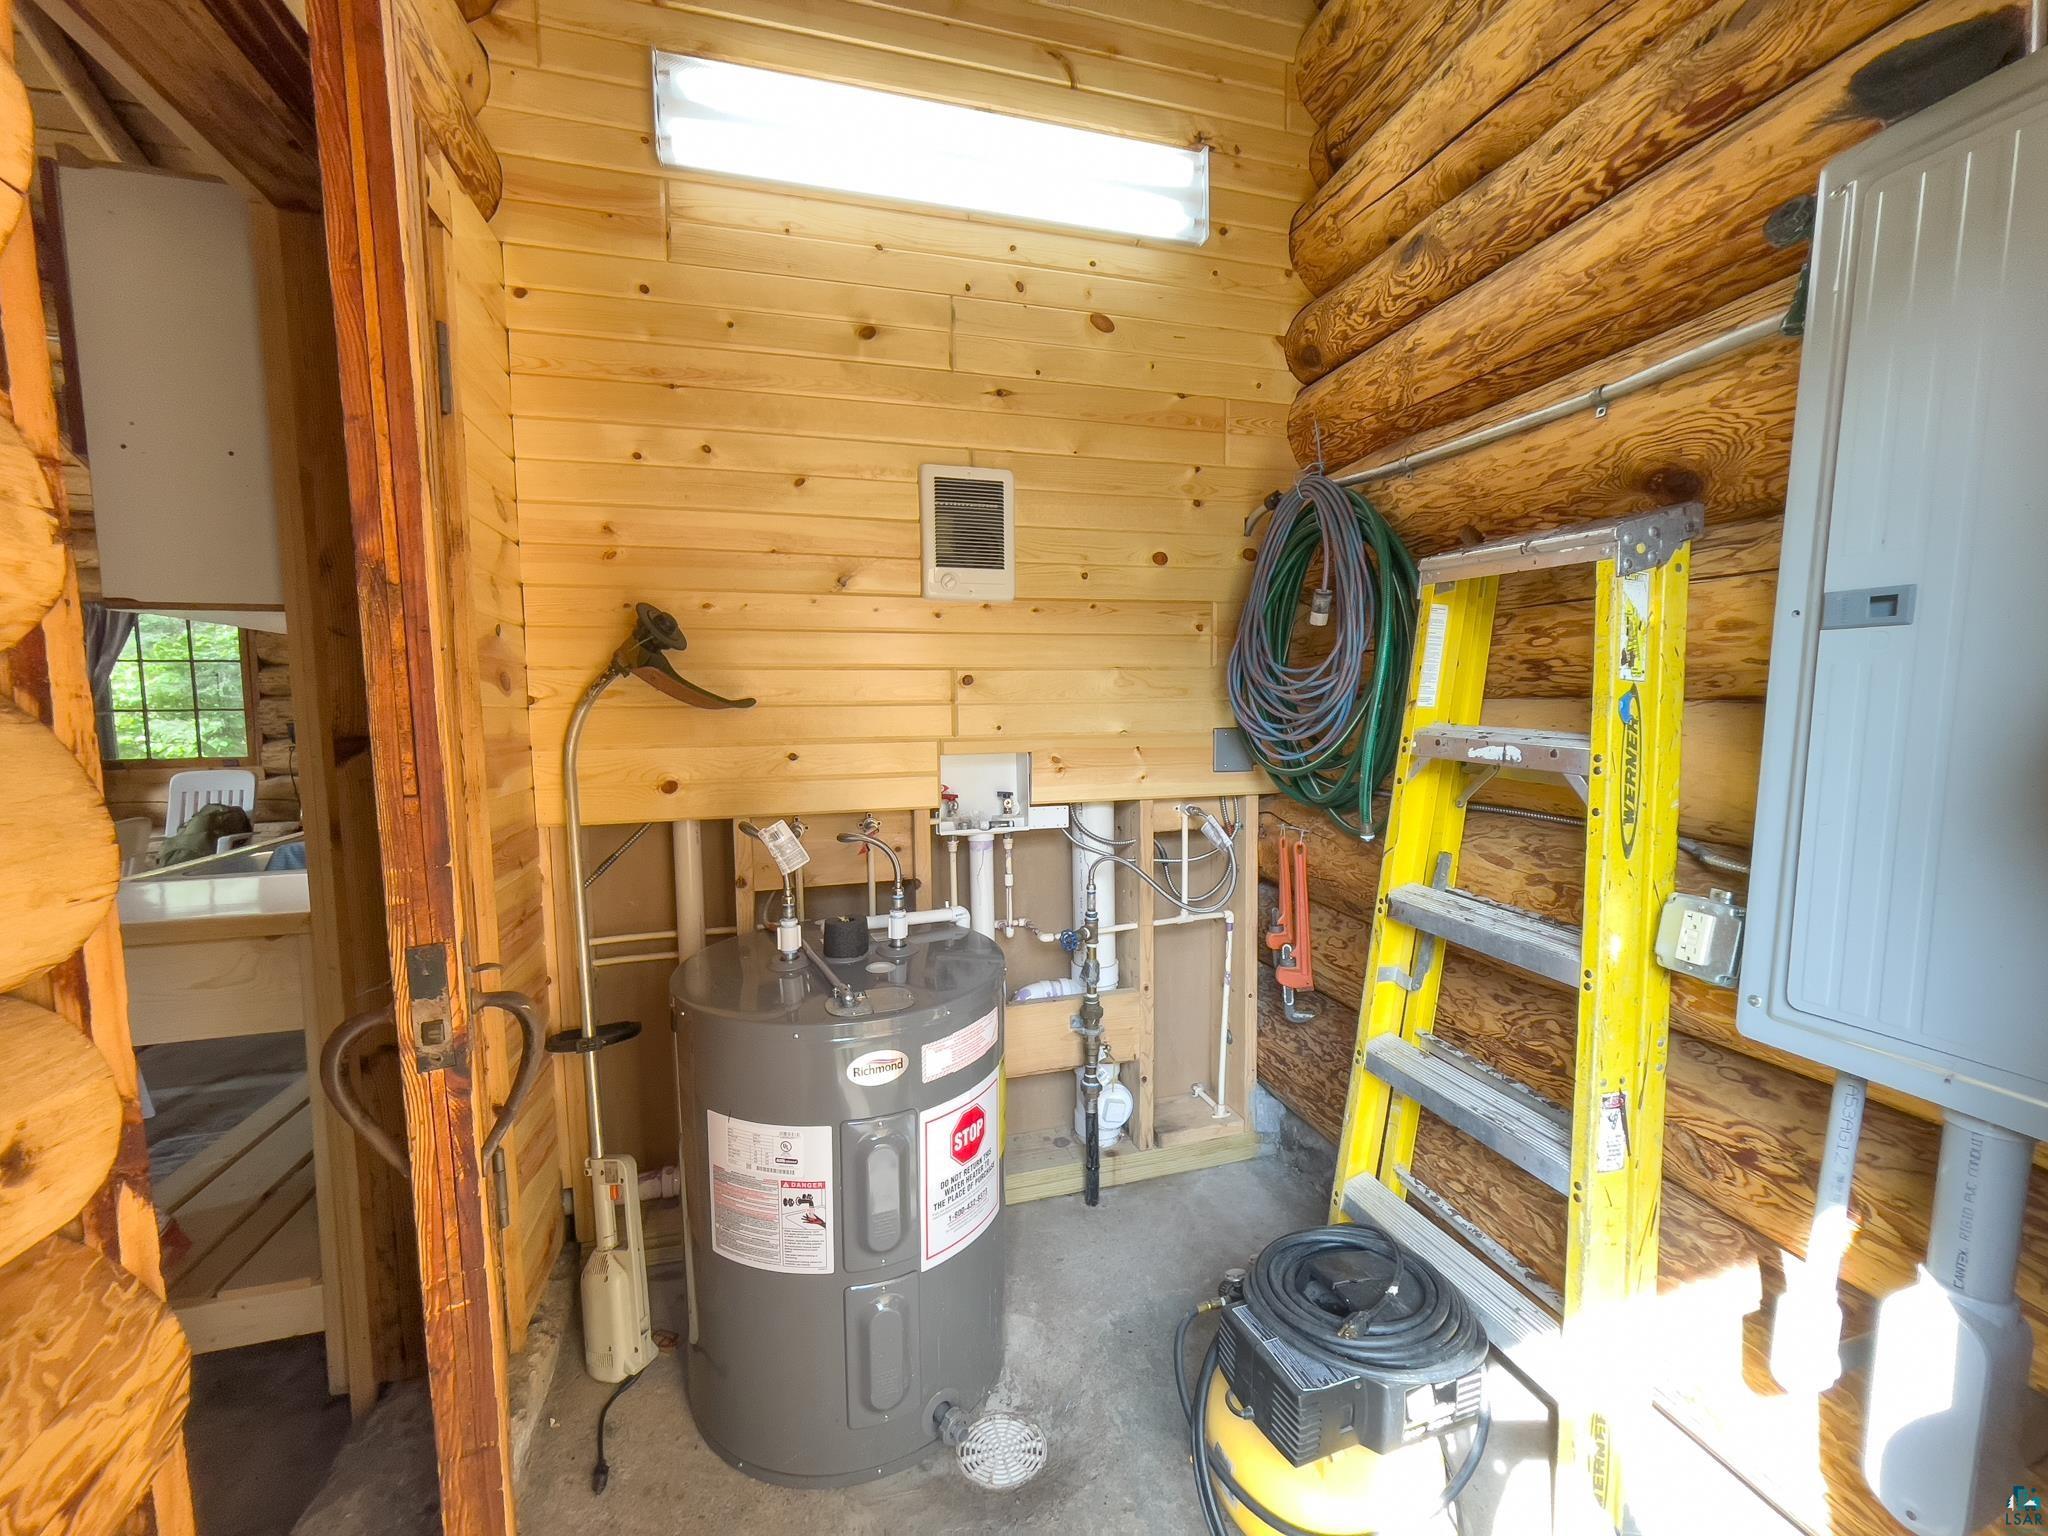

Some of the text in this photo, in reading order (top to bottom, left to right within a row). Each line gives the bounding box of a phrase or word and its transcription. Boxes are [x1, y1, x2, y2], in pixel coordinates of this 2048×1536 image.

[1623, 716, 1639, 826] WERNER
[853, 1058, 903, 1078] Richmond
[954, 1117, 984, 1152] STOP
[940, 1178, 949, 1190] DO
[951, 1171, 962, 1184] NOT
[964, 1158, 982, 1176] RETURN
[944, 1180, 964, 1196] WATER
[966, 1164, 983, 1183] HEATER
[933, 1199, 945, 1211] THE
[948, 1188, 965, 1204] PLACE
[967, 1181, 973, 1192] OF
[1964, 1181, 1977, 1203] PVC
[1959, 1205, 1975, 1242] RIGID
